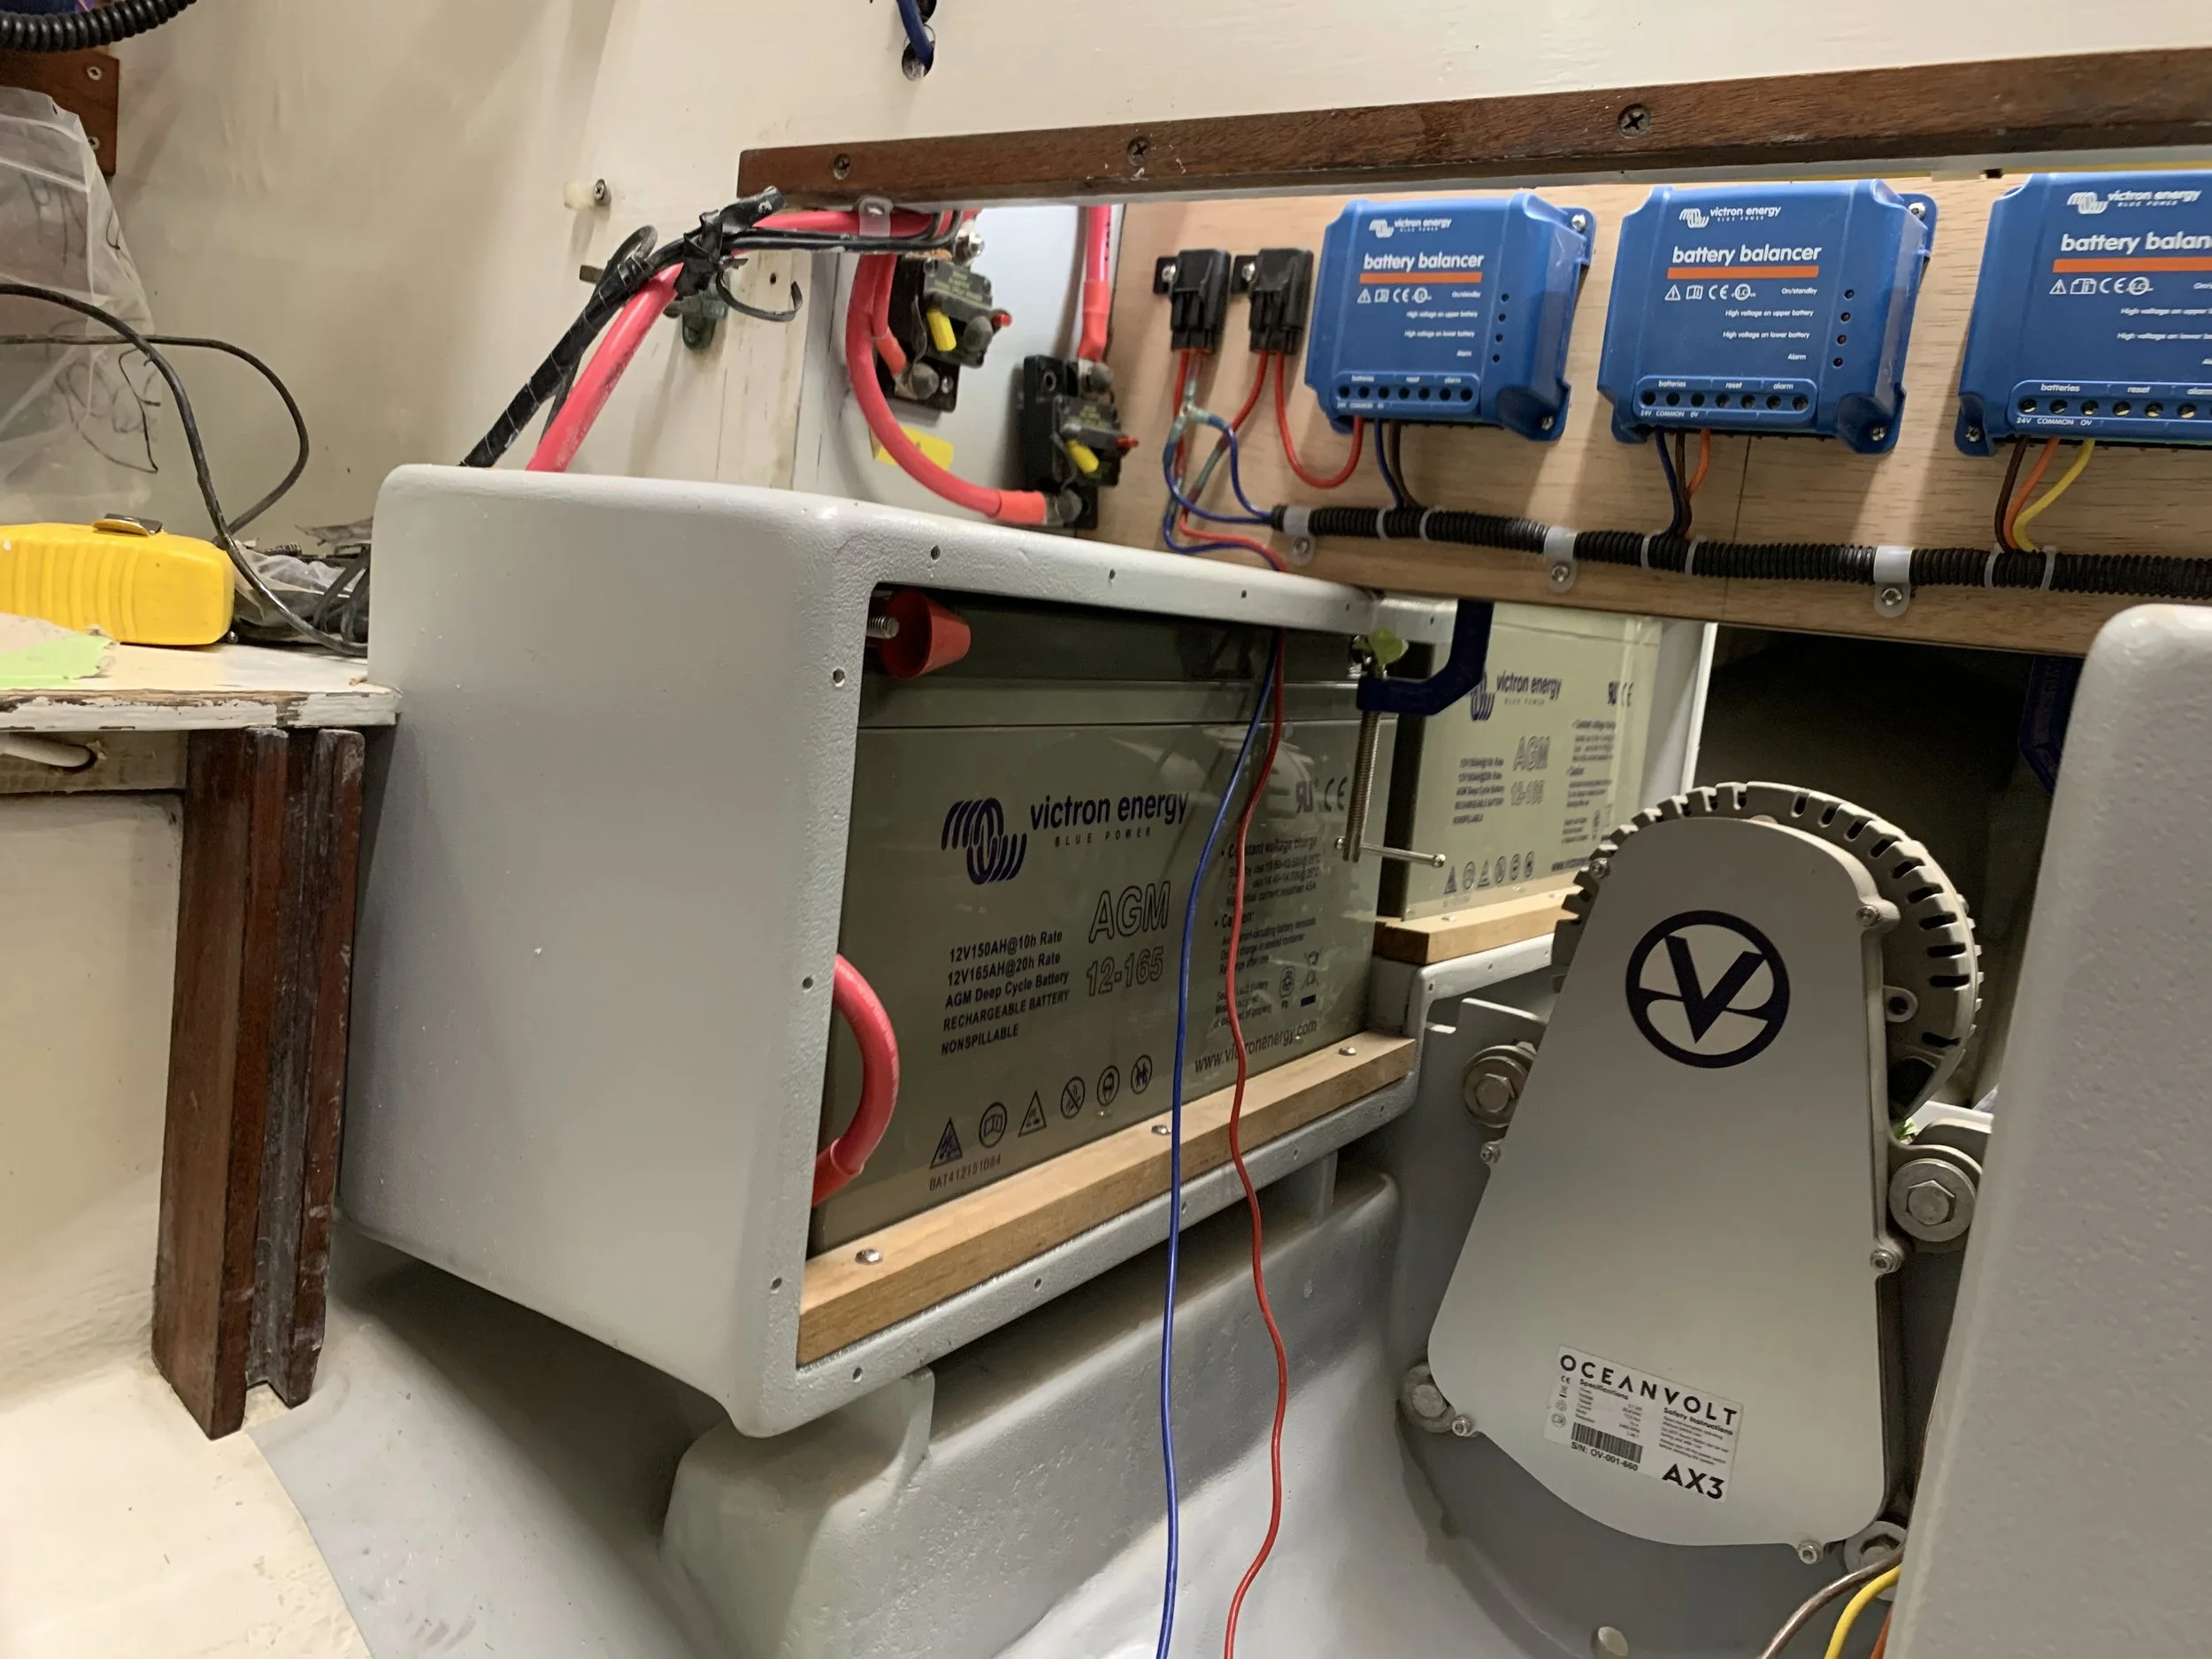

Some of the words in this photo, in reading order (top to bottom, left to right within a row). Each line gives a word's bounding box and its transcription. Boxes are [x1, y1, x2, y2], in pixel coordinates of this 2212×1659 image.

[2108, 189, 2153, 201] victron
[2154, 190, 2202, 202] energy
[1394, 218, 1422, 227] victron
[1423, 218, 1452, 228] energy
[1710, 206, 1743, 217] victron
[1746, 206, 1781, 218] energy
[1672, 246, 1736, 267] battery
[1740, 243, 1823, 262] balancer
[2061, 233, 2141, 255] battery
[1363, 252, 1416, 273] battery
[1417, 250, 1485, 269] balancer
[1725, 309, 1740, 318] High
[1740, 309, 1763, 318] voltage
[1723, 330, 1737, 339] High
[1738, 330, 1760, 339] voltage
[1788, 330, 1810, 339] battery
[2040, 383, 2080, 392] batteries
[1497, 670, 1529, 693] victron
[1531, 677, 1562, 700] energy
[1031, 795, 1110, 830] victron
[1118, 792, 1190, 826] energy
[1054, 832, 1092, 848] BLUE
[1105, 826, 1151, 841] POWER
[1088, 880, 1171, 944] AGM
[949, 933, 1036, 963] 12V150AH@10h
[1040, 929, 1062, 945] Rate
[948, 956, 1034, 987] 12V165AH@20h
[1038, 952, 1061, 967] Rate
[1086, 945, 1164, 997] 12-165
[945, 990, 972, 1010] AGM
[975, 987, 1002, 1002] Deep
[1005, 978, 1033, 997] Cycle
[1035, 971, 1070, 988] Battery
[943, 999, 1026, 1032] RECHARGEABLE
[1029, 989, 1070, 1010] BATTERY
[941, 1023, 1019, 1056] NONSPILLABLE
[1194, 1020, 1317, 1073] www.vironenergy.com
[1560, 1355, 1737, 1425] OCEANVOLT
[1579, 1379, 1629, 1400] Specifications
[1663, 1407, 1688, 1420] Safety
[1689, 1417, 1733, 1435] Instructions
[1571, 1441, 1588, 1454] S/N:
[1662, 1463, 1725, 1500] AX3
